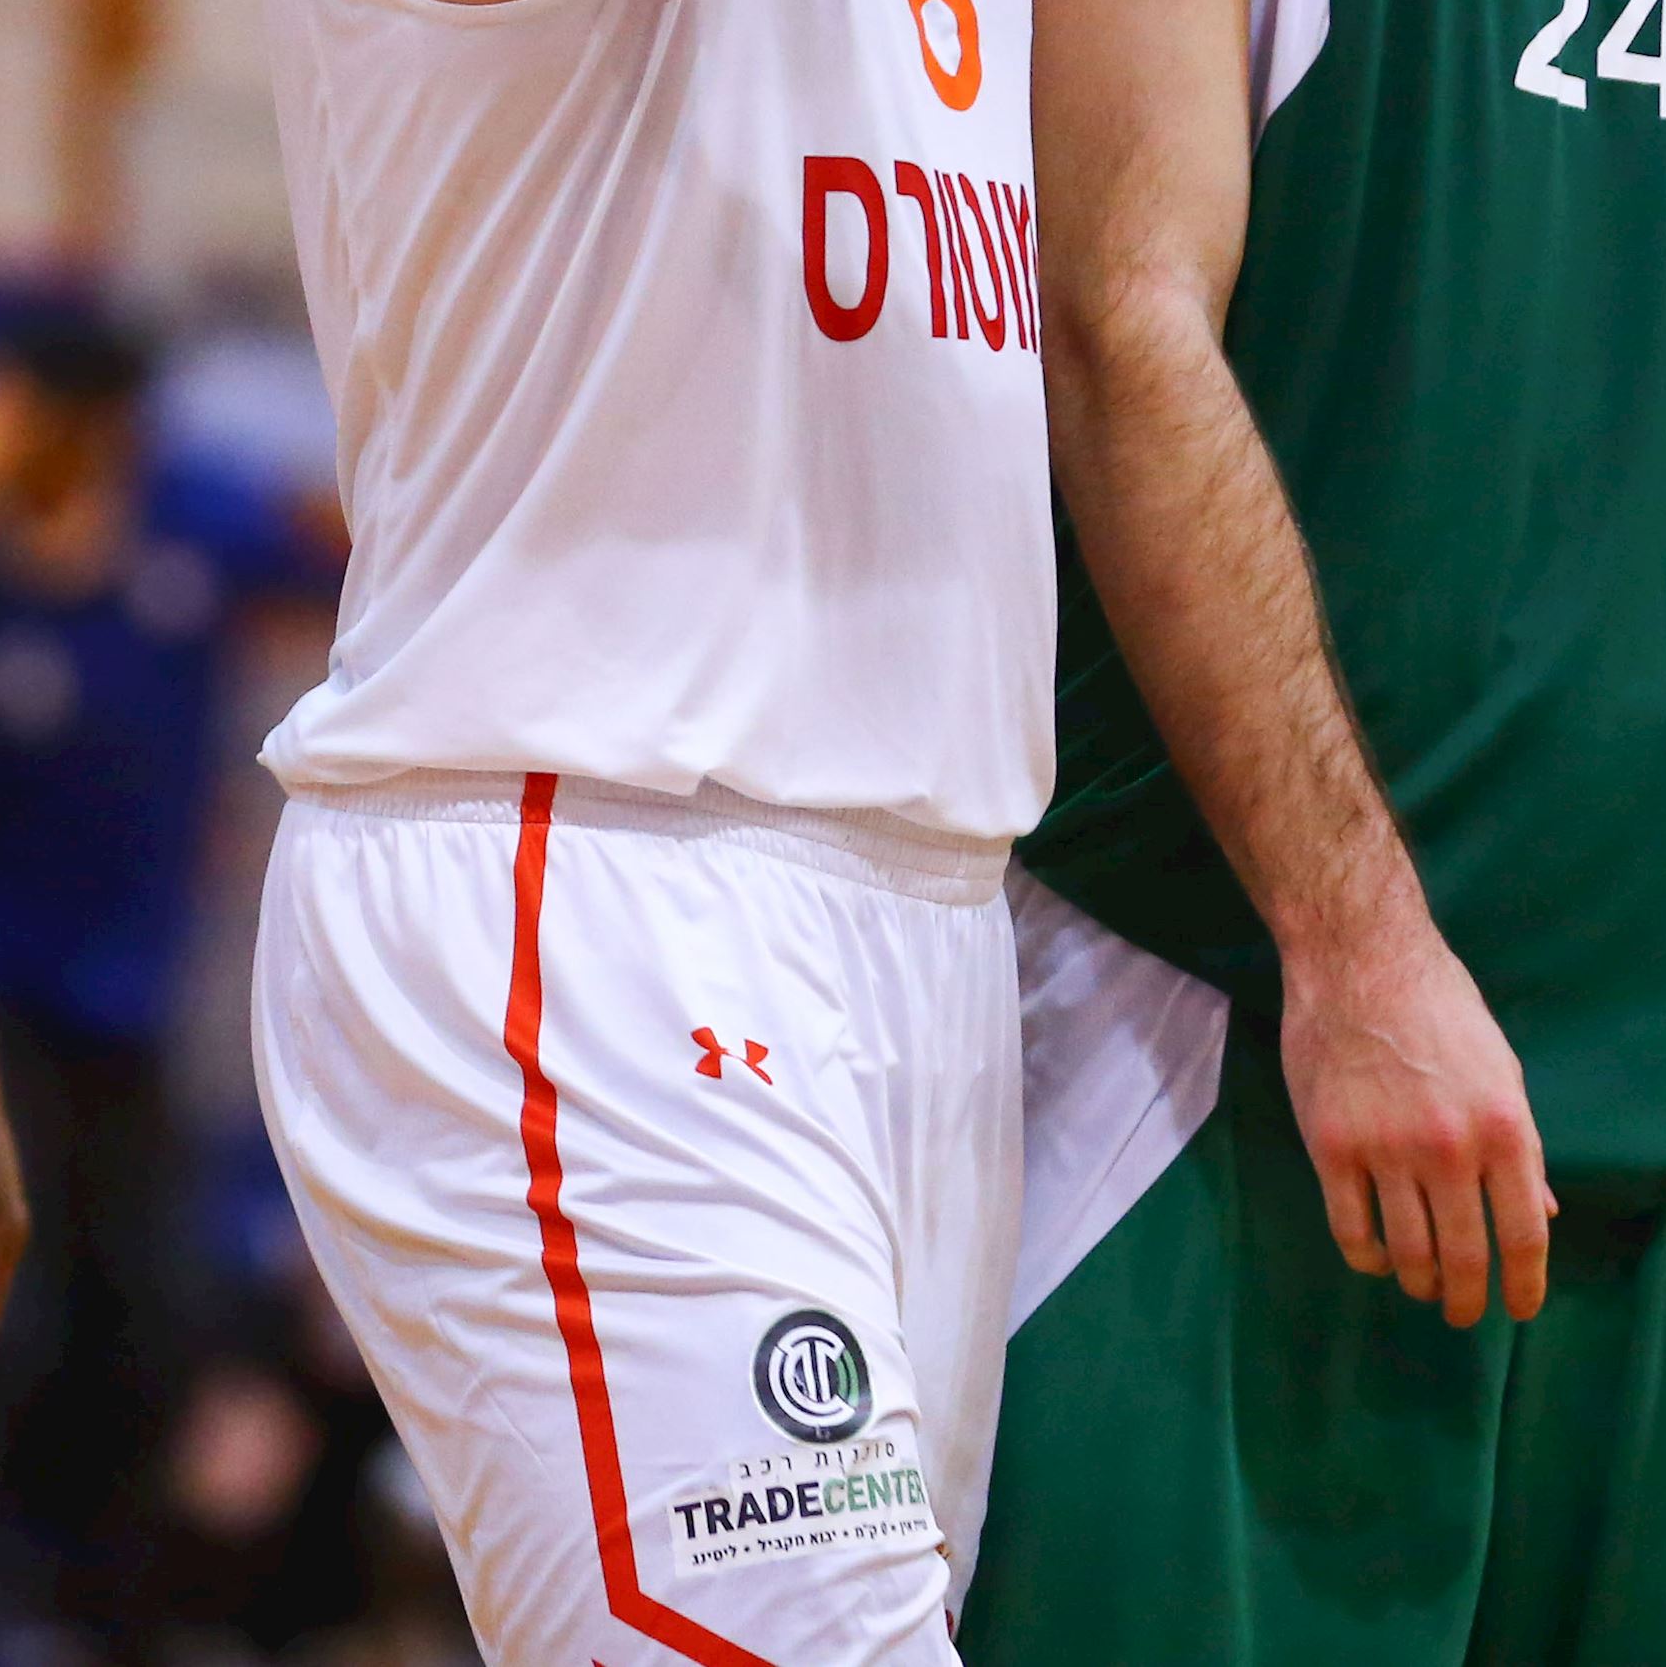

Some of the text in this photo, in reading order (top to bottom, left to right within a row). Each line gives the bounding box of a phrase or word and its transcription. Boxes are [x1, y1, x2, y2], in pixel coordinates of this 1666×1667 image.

[738, 1455, 793, 1479] רכב
[674, 1469, 927, 1540] TRADECENTER
[809, 1530, 836, 1545] יבוא
